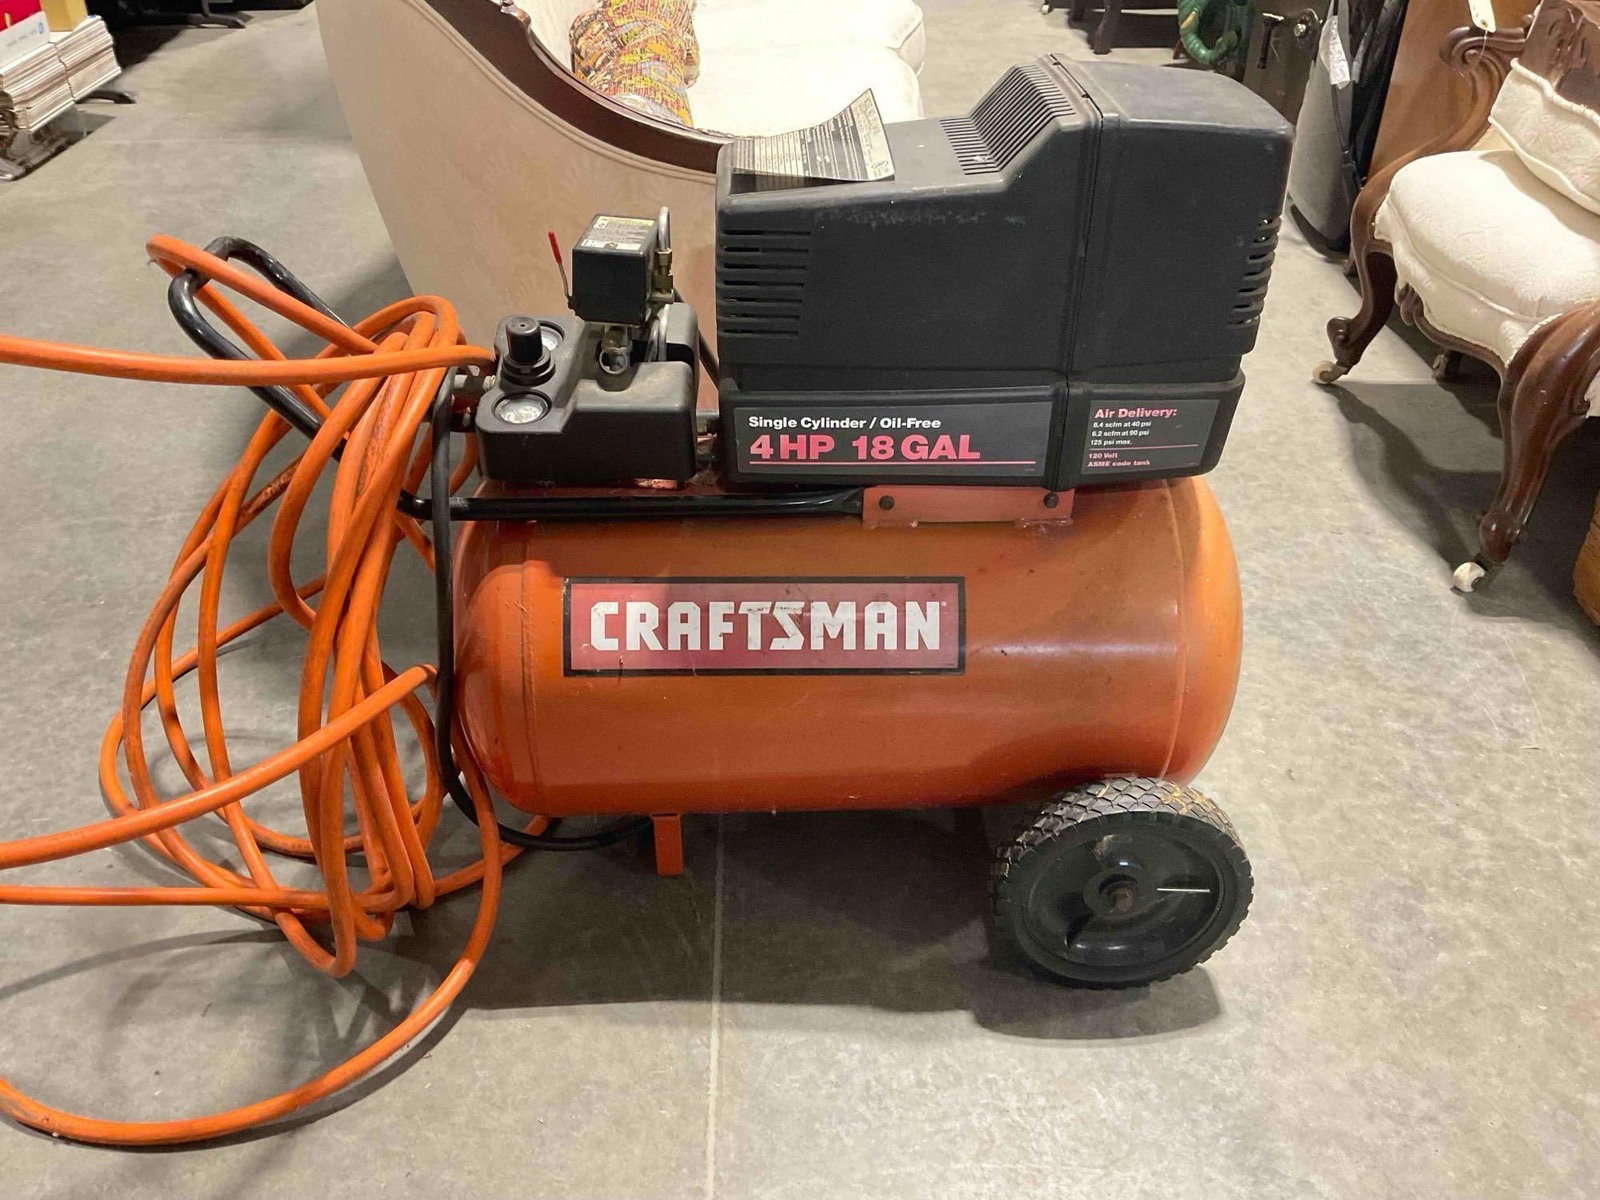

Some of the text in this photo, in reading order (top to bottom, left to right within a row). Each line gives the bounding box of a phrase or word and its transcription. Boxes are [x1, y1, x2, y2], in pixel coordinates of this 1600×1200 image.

[1094, 407, 1178, 419] Air Delivery:
[749, 416, 942, 429] Single Cylinder / Oil-Free
[749, 434, 981, 460] 4 HP 18 GAL
[1103, 439, 1115, 447] psi
[590, 600, 941, 651] CRAFTSMAN
